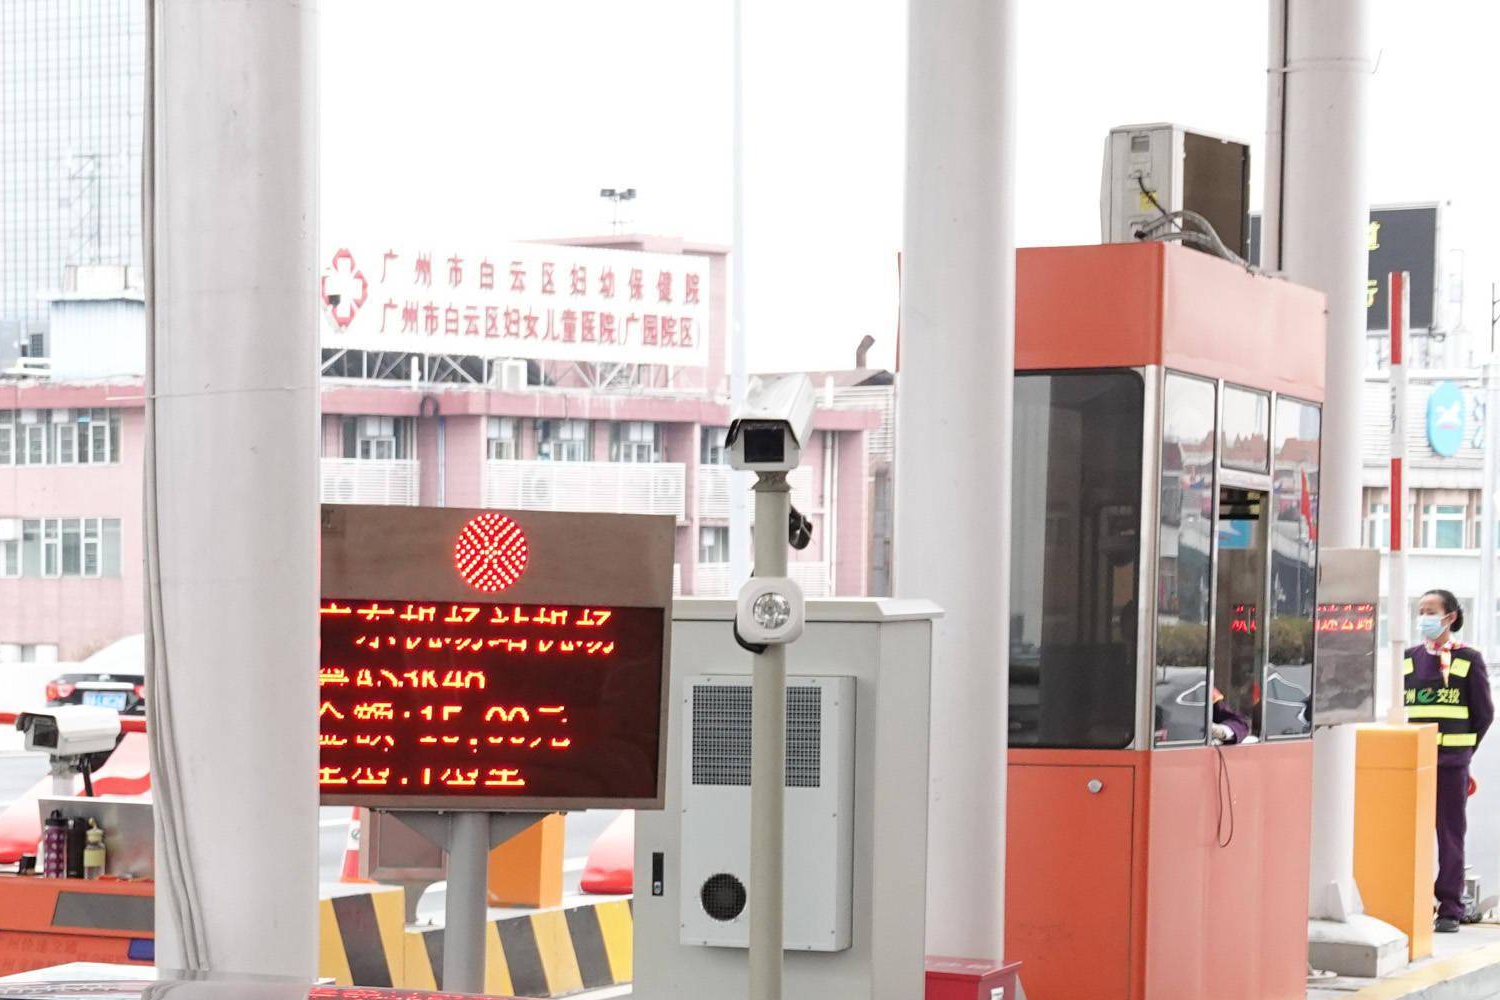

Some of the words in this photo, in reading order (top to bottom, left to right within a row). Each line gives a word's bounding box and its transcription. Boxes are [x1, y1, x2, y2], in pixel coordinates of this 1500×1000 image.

[380, 248, 700, 305] 广州市白云区妇幼保健院
